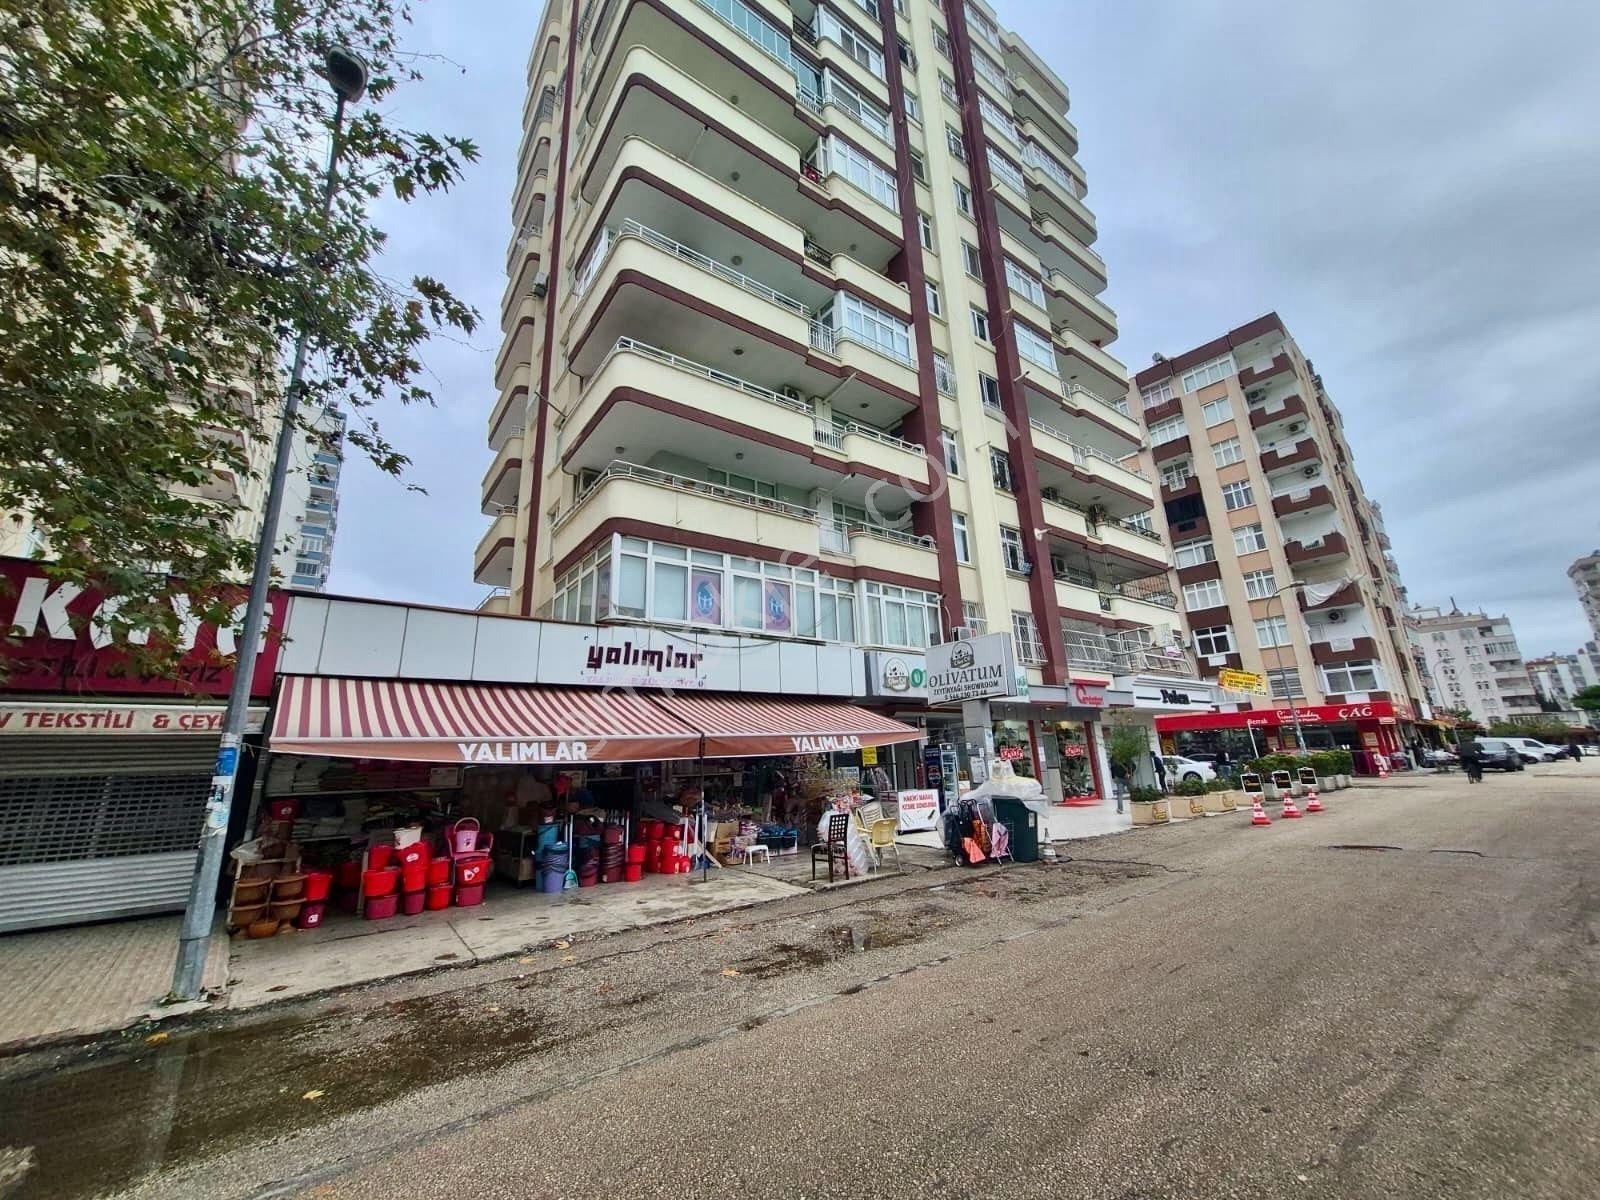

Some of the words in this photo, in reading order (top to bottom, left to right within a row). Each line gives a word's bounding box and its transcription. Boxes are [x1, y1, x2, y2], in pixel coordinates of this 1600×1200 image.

[929, 663, 1002, 688] OLİVATUM
[23, 709, 134, 729] TEKSTİLİ
[153, 713, 170, 729] &
[180, 712, 225, 731] ÇEYİ
[1338, 704, 1373, 720] ÇAĞ
[458, 741, 588, 762] YALIMLAR
[791, 735, 861, 752] YALIMLAR
